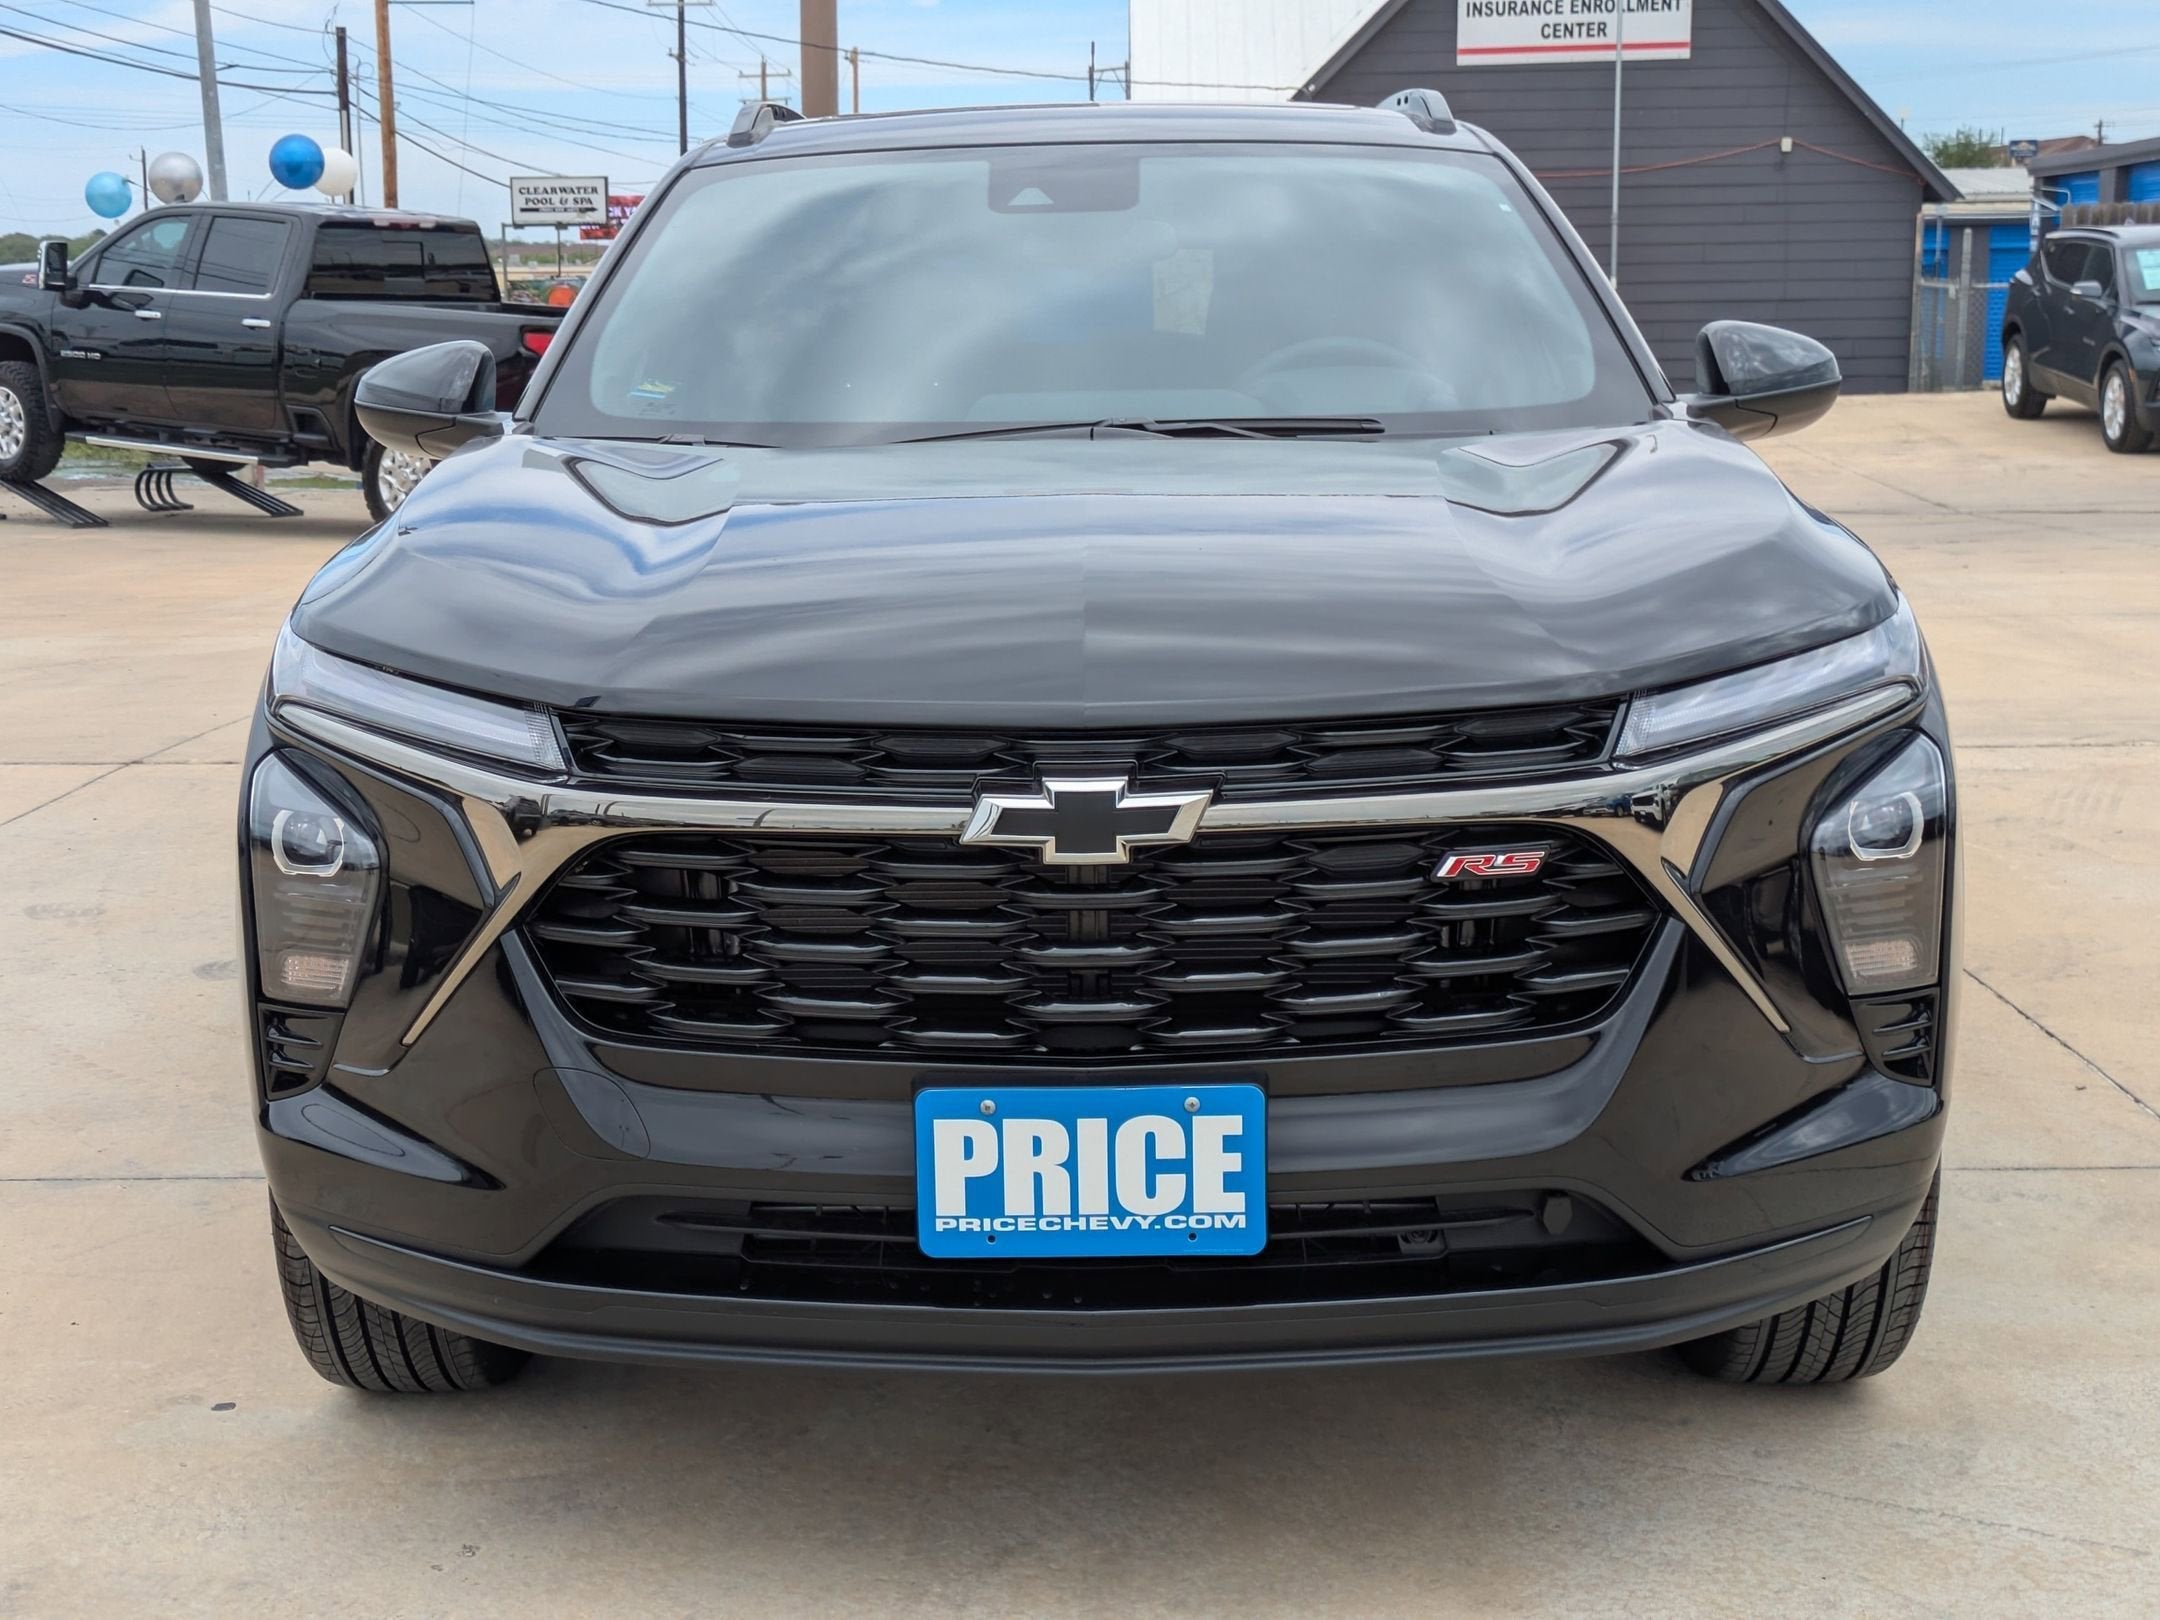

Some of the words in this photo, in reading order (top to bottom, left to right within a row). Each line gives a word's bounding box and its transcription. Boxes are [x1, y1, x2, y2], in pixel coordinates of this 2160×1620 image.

[1466, 0, 1564, 18] INSURANCE
[1570, 0, 1682, 15] ENROLMENT
[1541, 21, 1608, 39] CENTER
[518, 186, 599, 195] CLEARWATER
[524, 197, 555, 206] POOL
[573, 196, 594, 205] SPA
[1437, 851, 1545, 877] RS
[933, 1115, 1246, 1216] PRICE
[935, 1213, 1246, 1232] PRICECHEVY.COM
